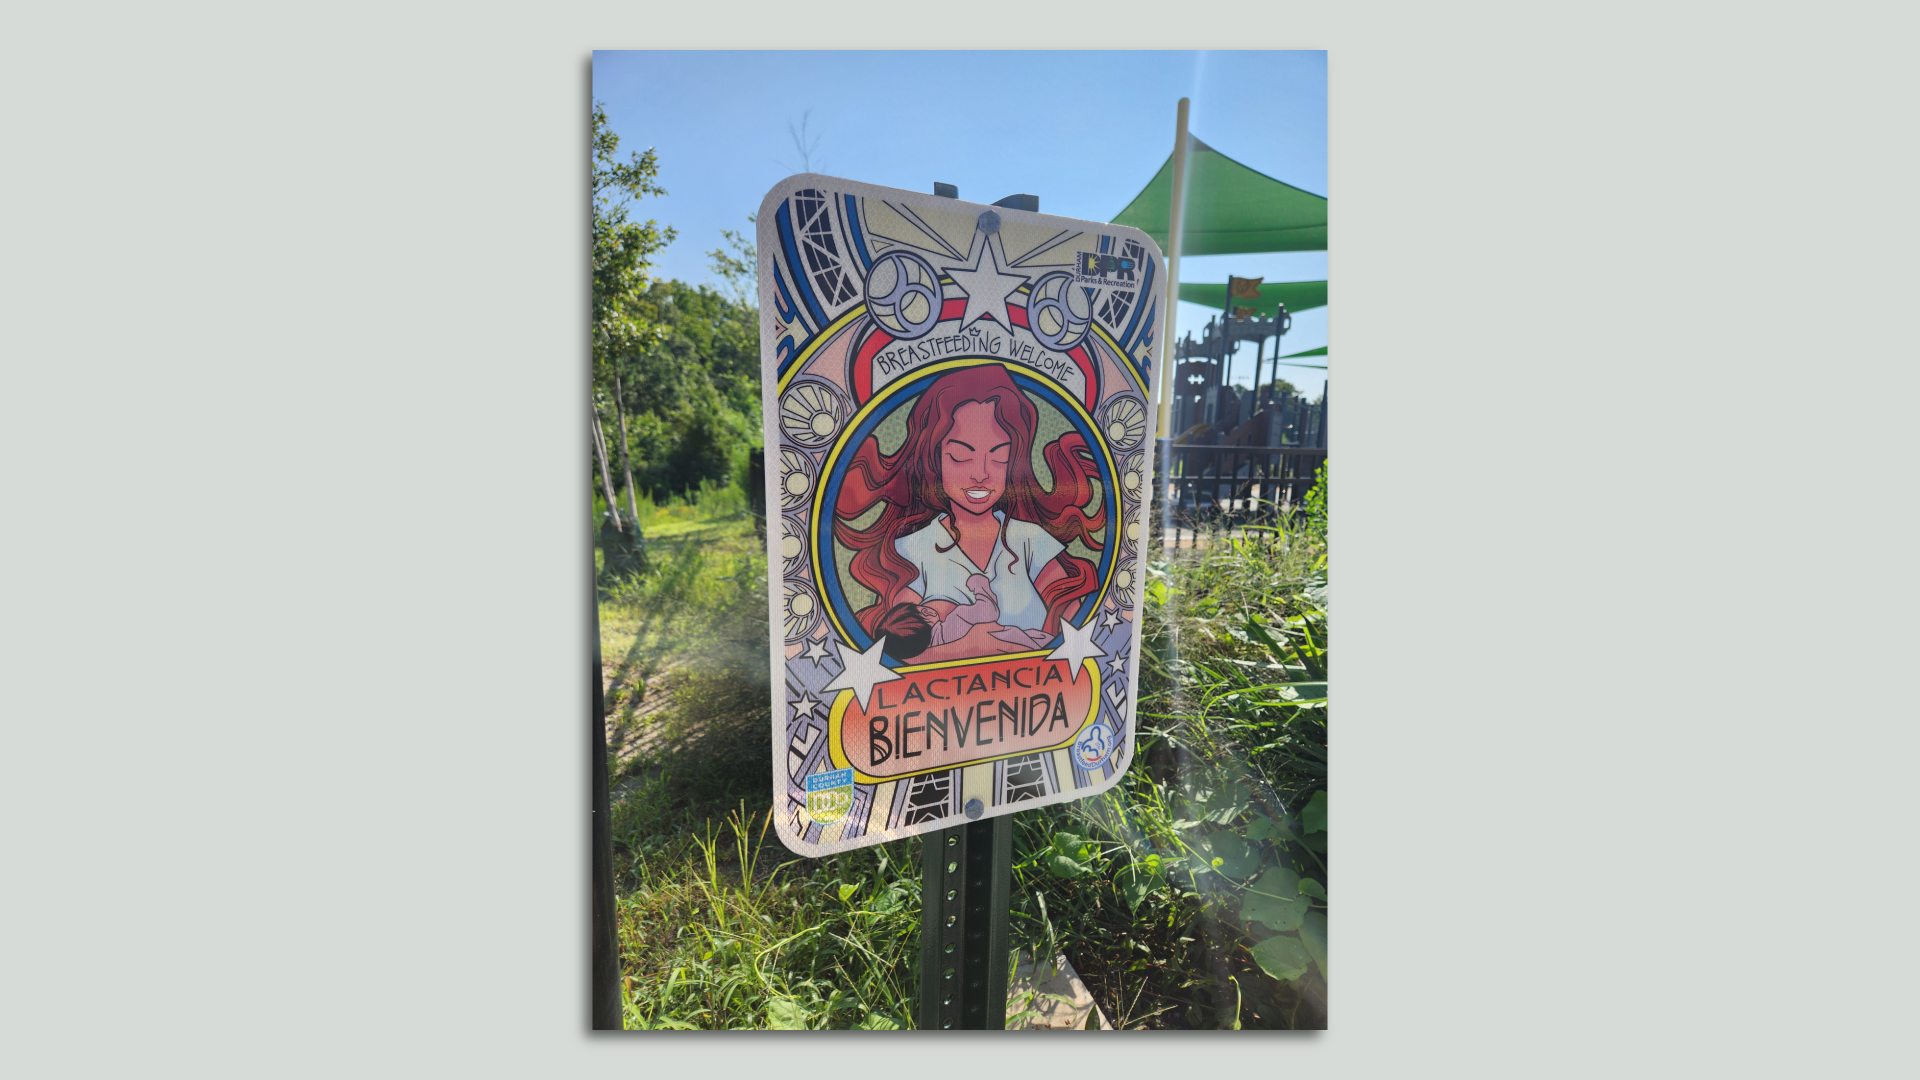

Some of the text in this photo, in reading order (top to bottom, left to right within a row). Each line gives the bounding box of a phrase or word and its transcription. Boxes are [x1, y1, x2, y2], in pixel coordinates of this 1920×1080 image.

[1081, 252, 1136, 281] DPR
[1081, 276, 1098, 285] Parks
[1103, 278, 1136, 289] Recreation
[876, 331, 1075, 382] BREASTFEEDING WELCOME
[877, 663, 1064, 710] LACTANCIA
[869, 691, 1070, 767] BIENVENIDA
[812, 772, 847, 784] DURHAM
[812, 779, 847, 790] COUNTY
